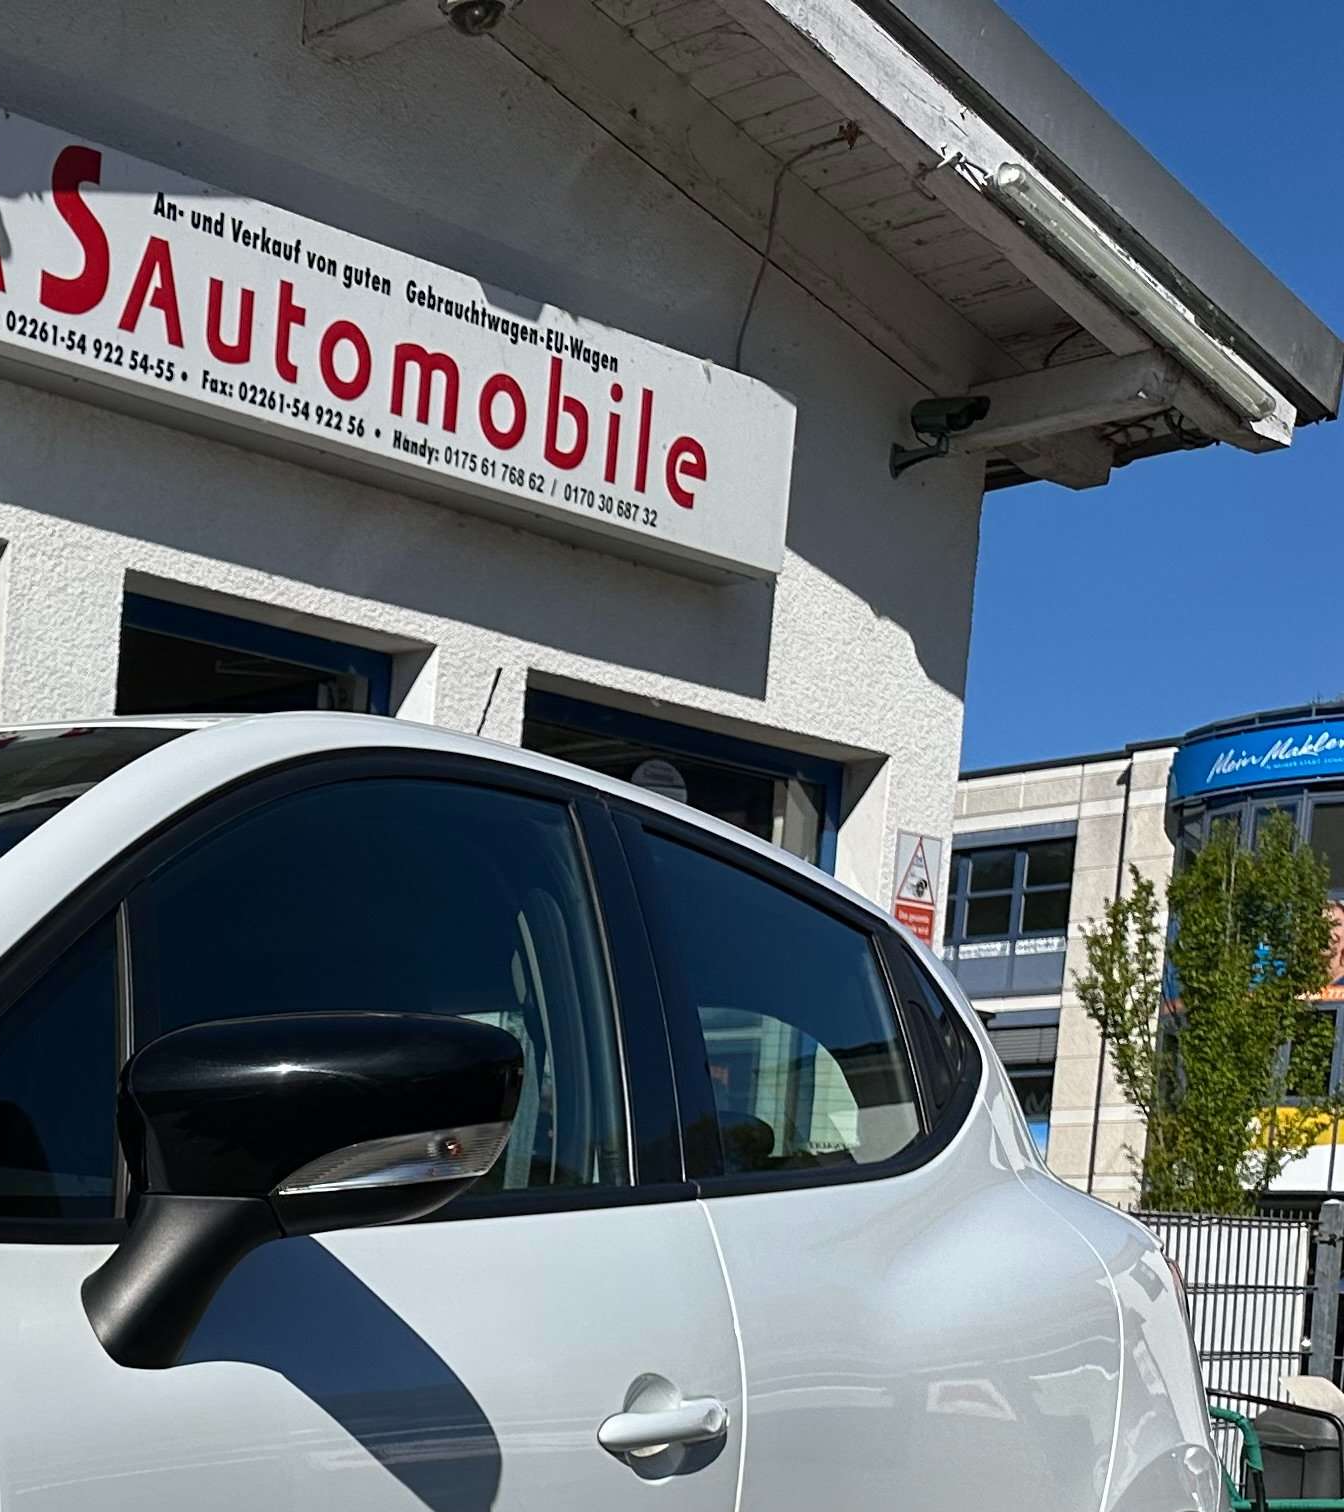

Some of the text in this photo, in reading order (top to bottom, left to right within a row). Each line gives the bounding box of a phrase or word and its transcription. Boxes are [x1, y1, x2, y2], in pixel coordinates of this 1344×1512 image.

[118, 236, 709, 512] Automobile
[153, 191, 619, 373] An- und Verkauf von guten Gebrauchtwagen-EU-Wagen
[6, 310, 87, 355] 02261-54
[93, 338, 124, 366] 922
[128, 349, 175, 382] 54-55
[202, 369, 234, 398] Fax:
[238, 382, 310, 421] 02261-54
[315, 405, 343, 432] 922
[348, 416, 365, 438] 56
[393, 430, 440, 466] Handy:
[444, 446, 478, 473] 0175
[481, 457, 496, 478] 61
[501, 463, 525, 487] 768
[528, 472, 545, 494] 62
[564, 483, 594, 509] 0170
[597, 493, 614, 515] 30
[616, 500, 640, 523] 687
[642, 509, 658, 528] 32
